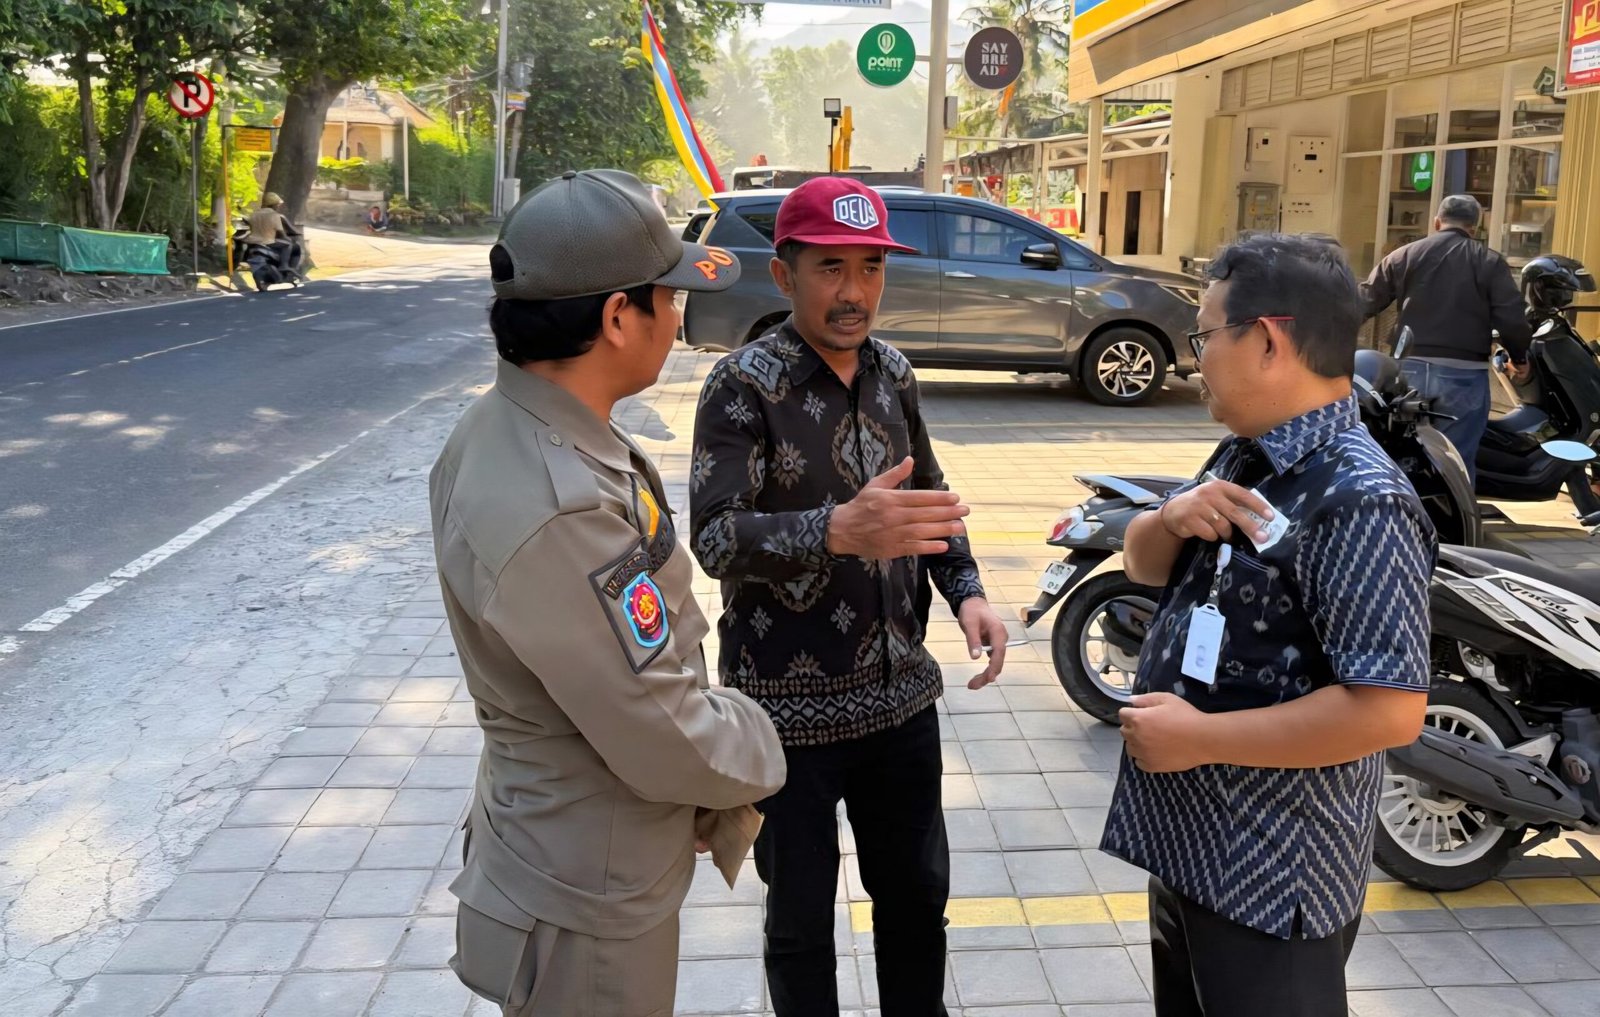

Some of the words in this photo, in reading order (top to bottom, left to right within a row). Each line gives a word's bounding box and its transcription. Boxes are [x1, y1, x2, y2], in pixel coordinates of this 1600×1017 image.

[981, 42, 1008, 54] SAY
[979, 65, 999, 76] AD
[838, 197, 876, 224] DEUS
